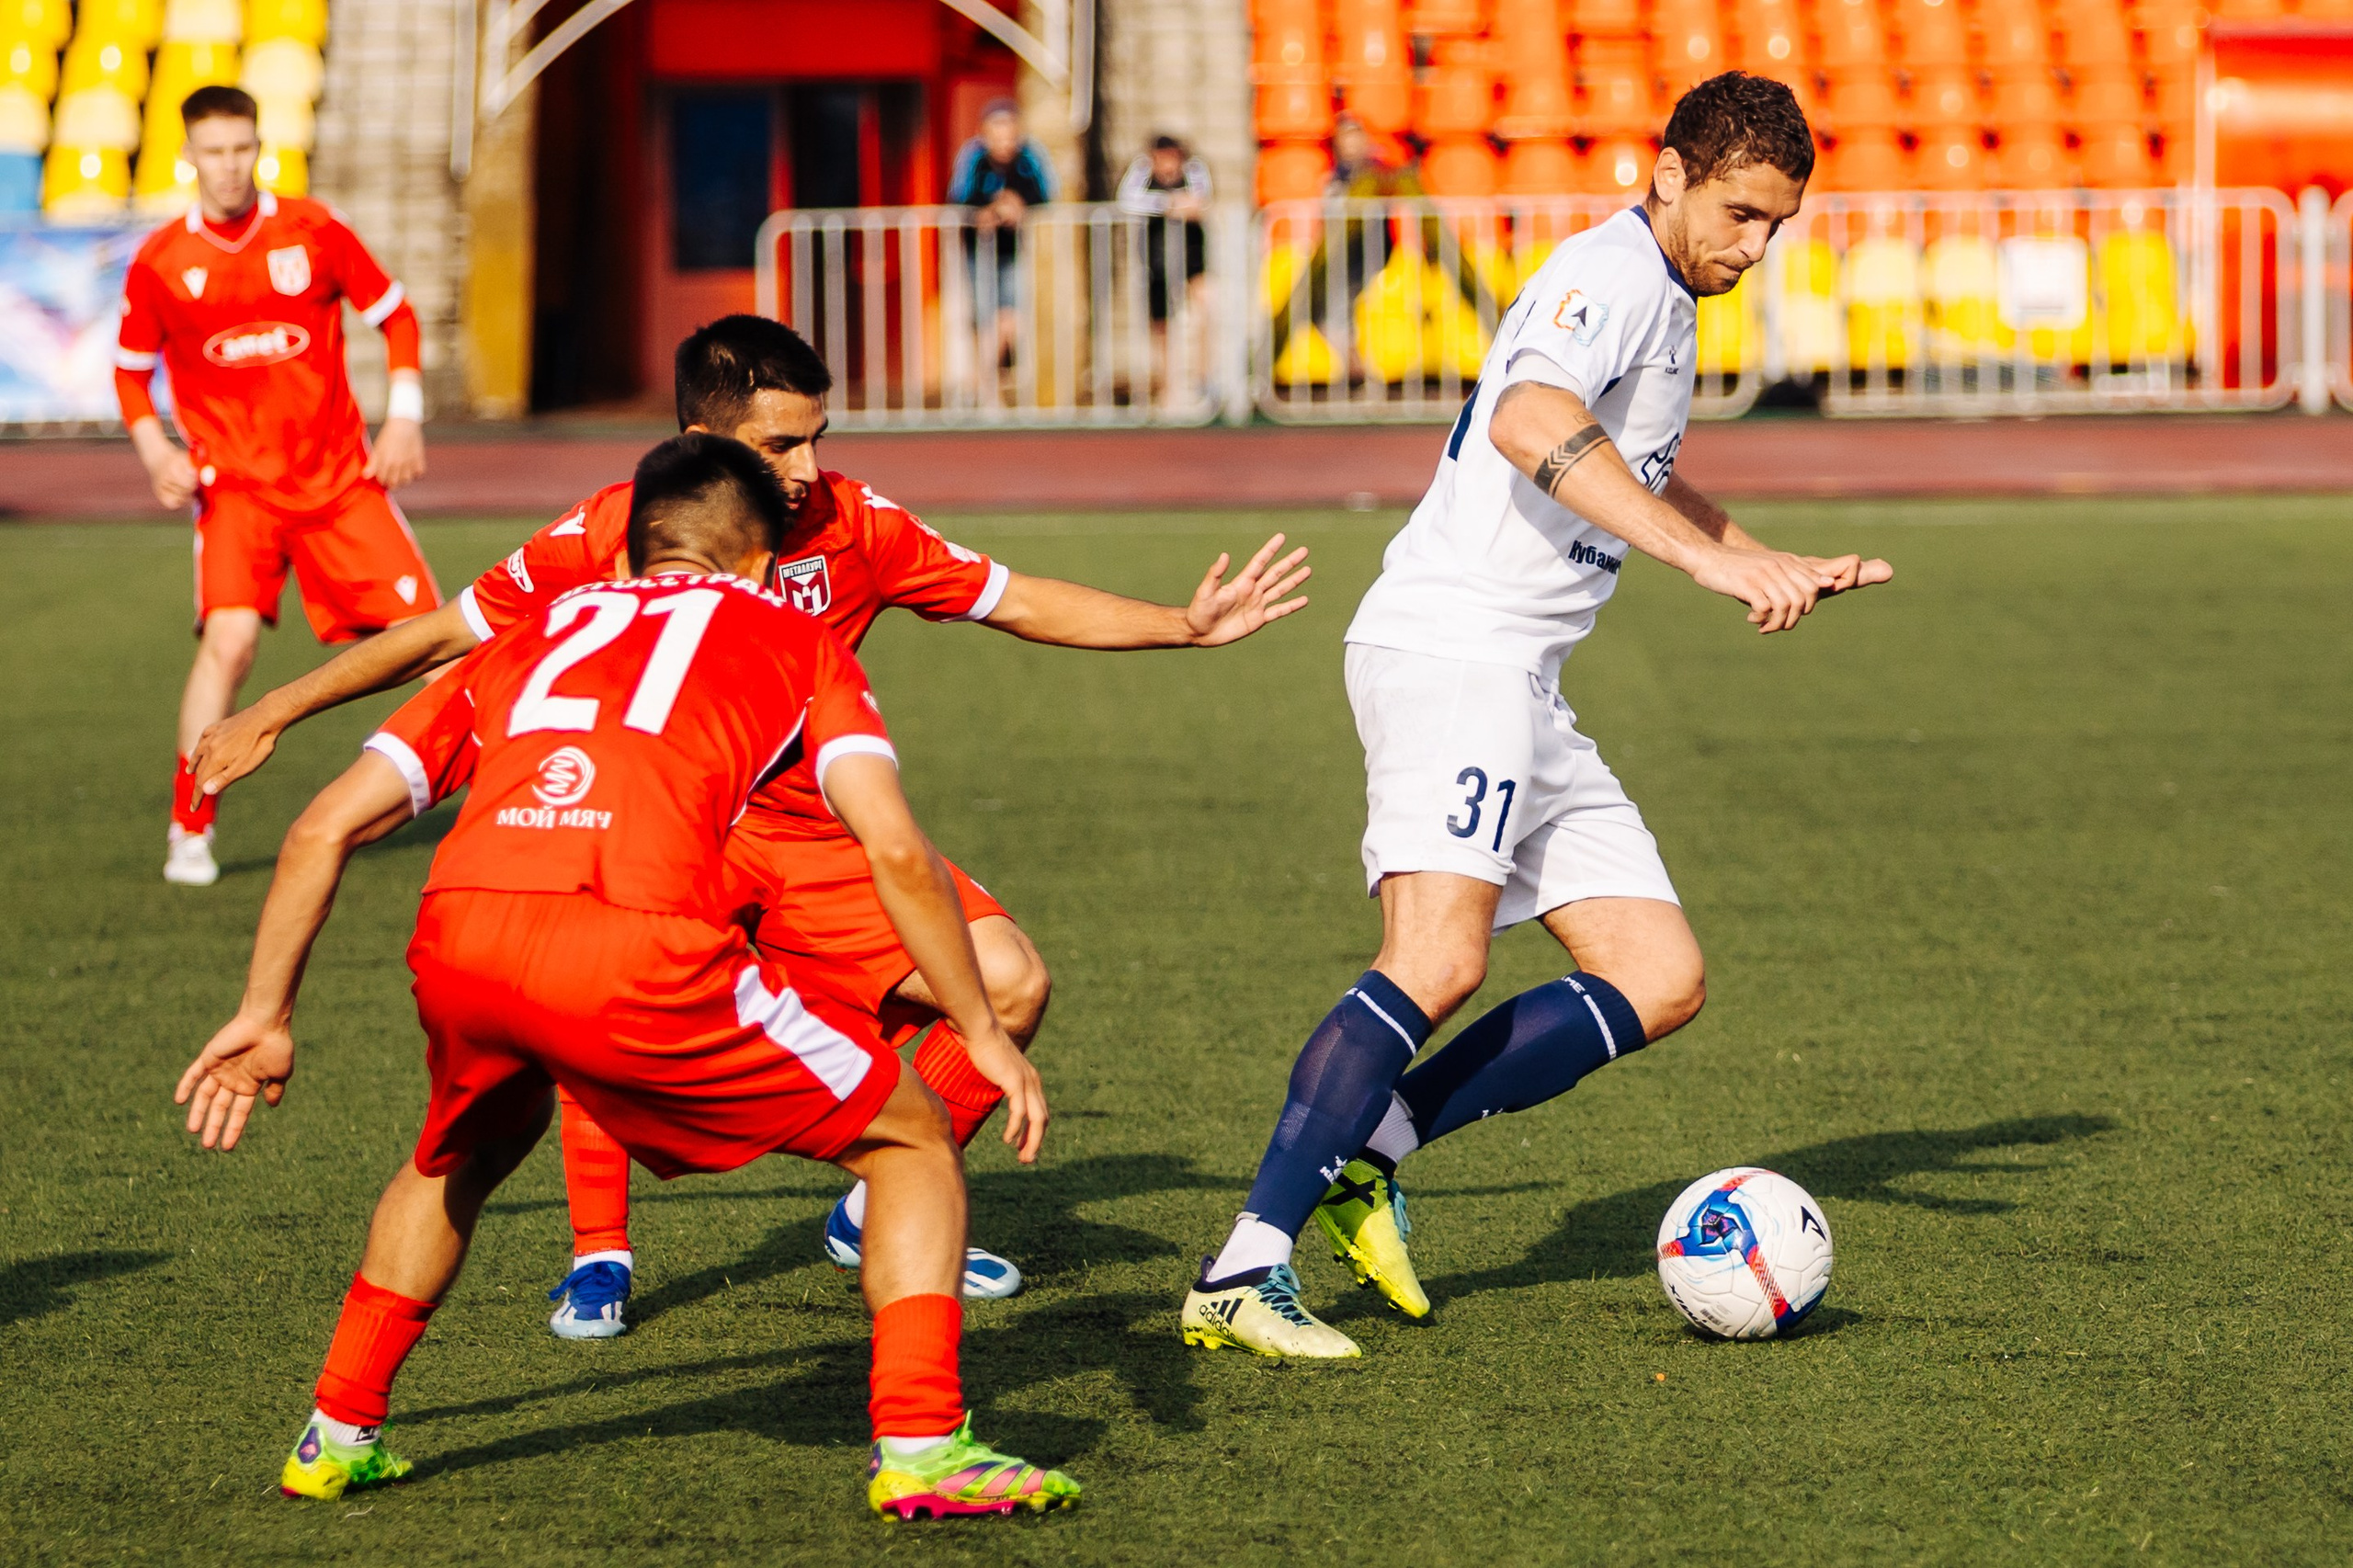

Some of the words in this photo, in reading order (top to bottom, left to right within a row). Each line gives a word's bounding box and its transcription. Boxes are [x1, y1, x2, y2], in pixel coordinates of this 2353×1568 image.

[506, 588, 724, 737] 21
[496, 805, 556, 828] МОЙ
[559, 809, 613, 829] МЯЧ
[1447, 767, 1517, 853] 31
[1199, 1304, 1238, 1343] adidas
